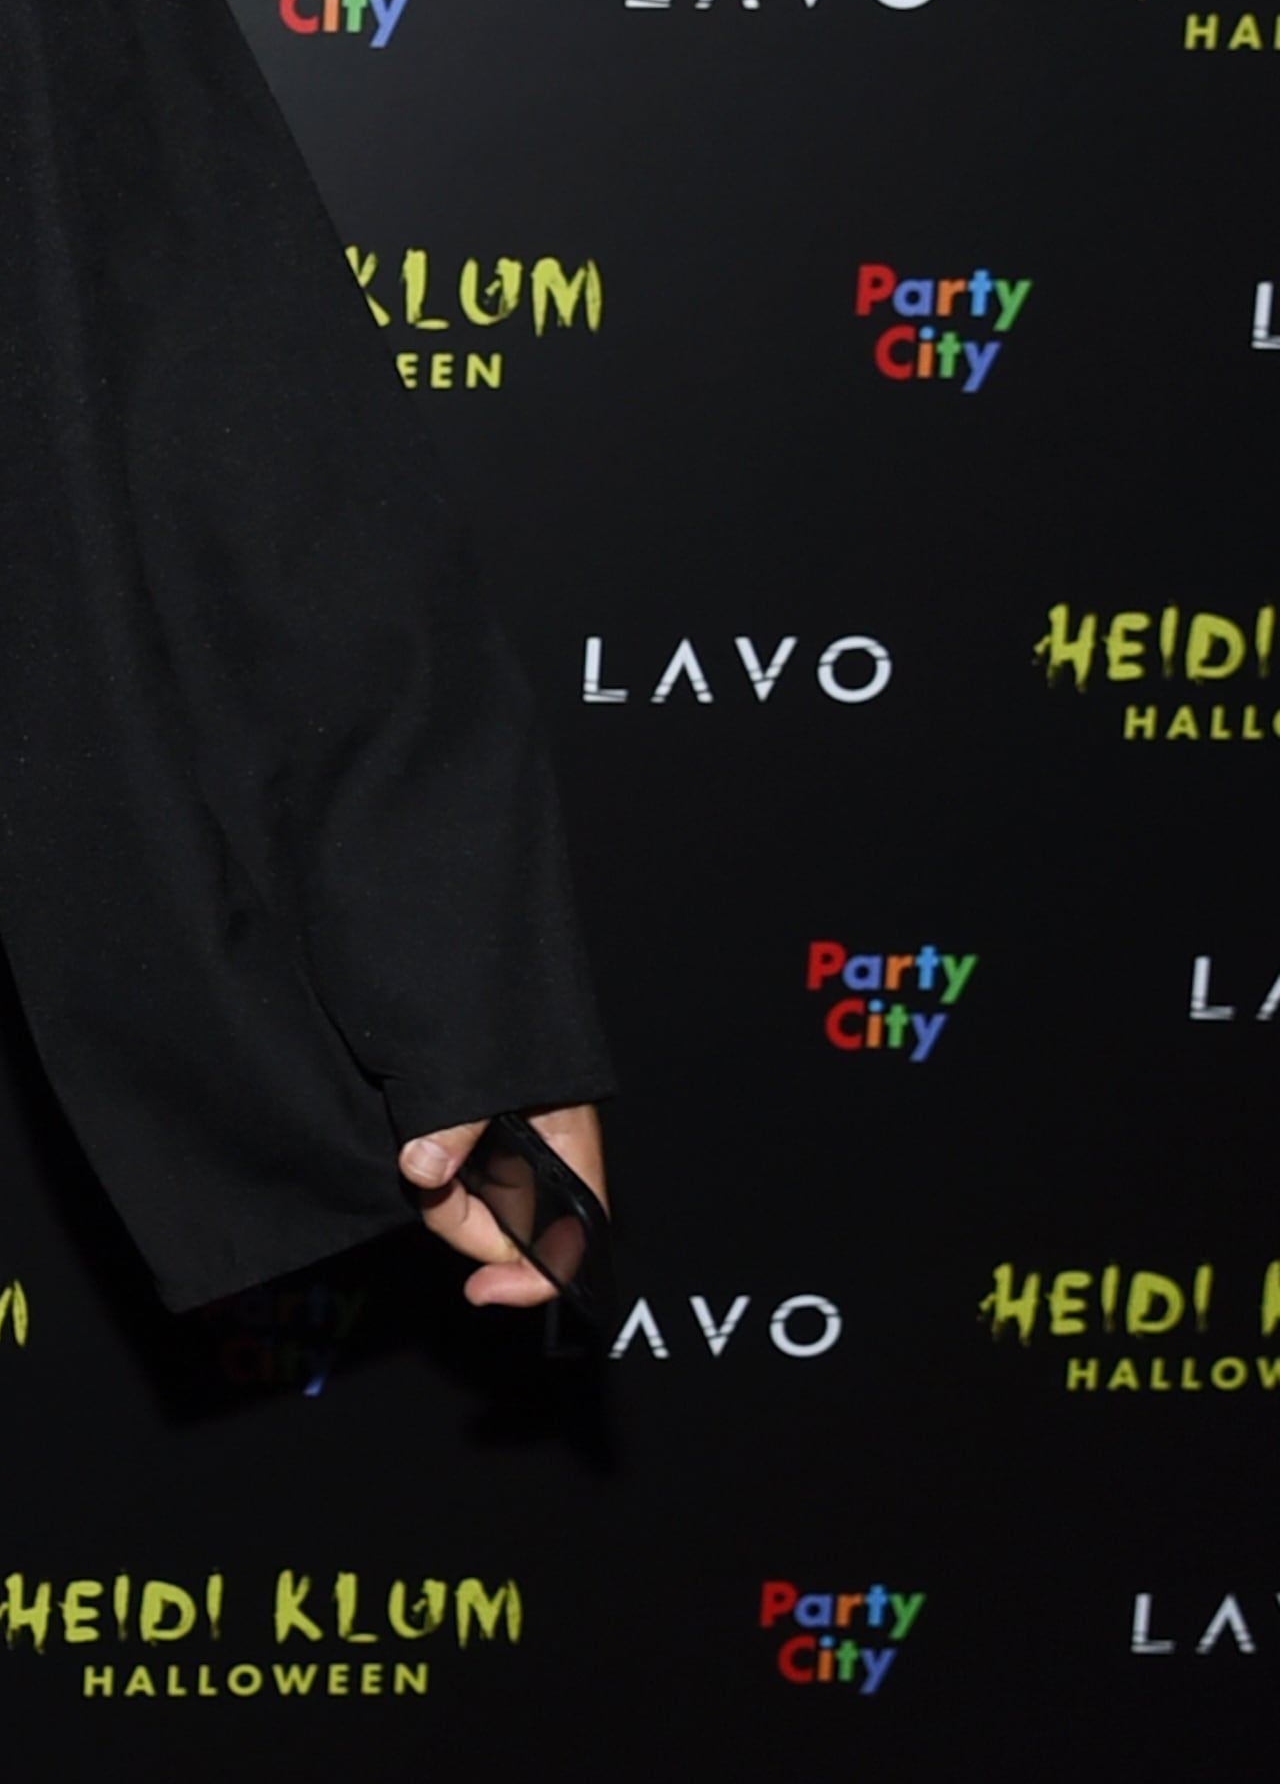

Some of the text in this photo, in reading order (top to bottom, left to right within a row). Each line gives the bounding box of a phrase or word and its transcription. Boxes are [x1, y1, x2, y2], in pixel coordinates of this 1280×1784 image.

[856, 263, 1031, 331] Party
[875, 324, 1001, 393] City
[583, 636, 892, 703] LAVO
[1034, 604, 1274, 686] HEIDI
[807, 941, 976, 1003] Party
[825, 997, 947, 1062] City
[980, 1263, 1212, 1339] HEIDI
[274, 1570, 521, 1646] KLUM
[760, 1581, 924, 1639] Party
[1132, 1593, 1280, 1653] LA
[84, 1663, 427, 1696] HALLOWEEN
[778, 1635, 896, 1694] City
